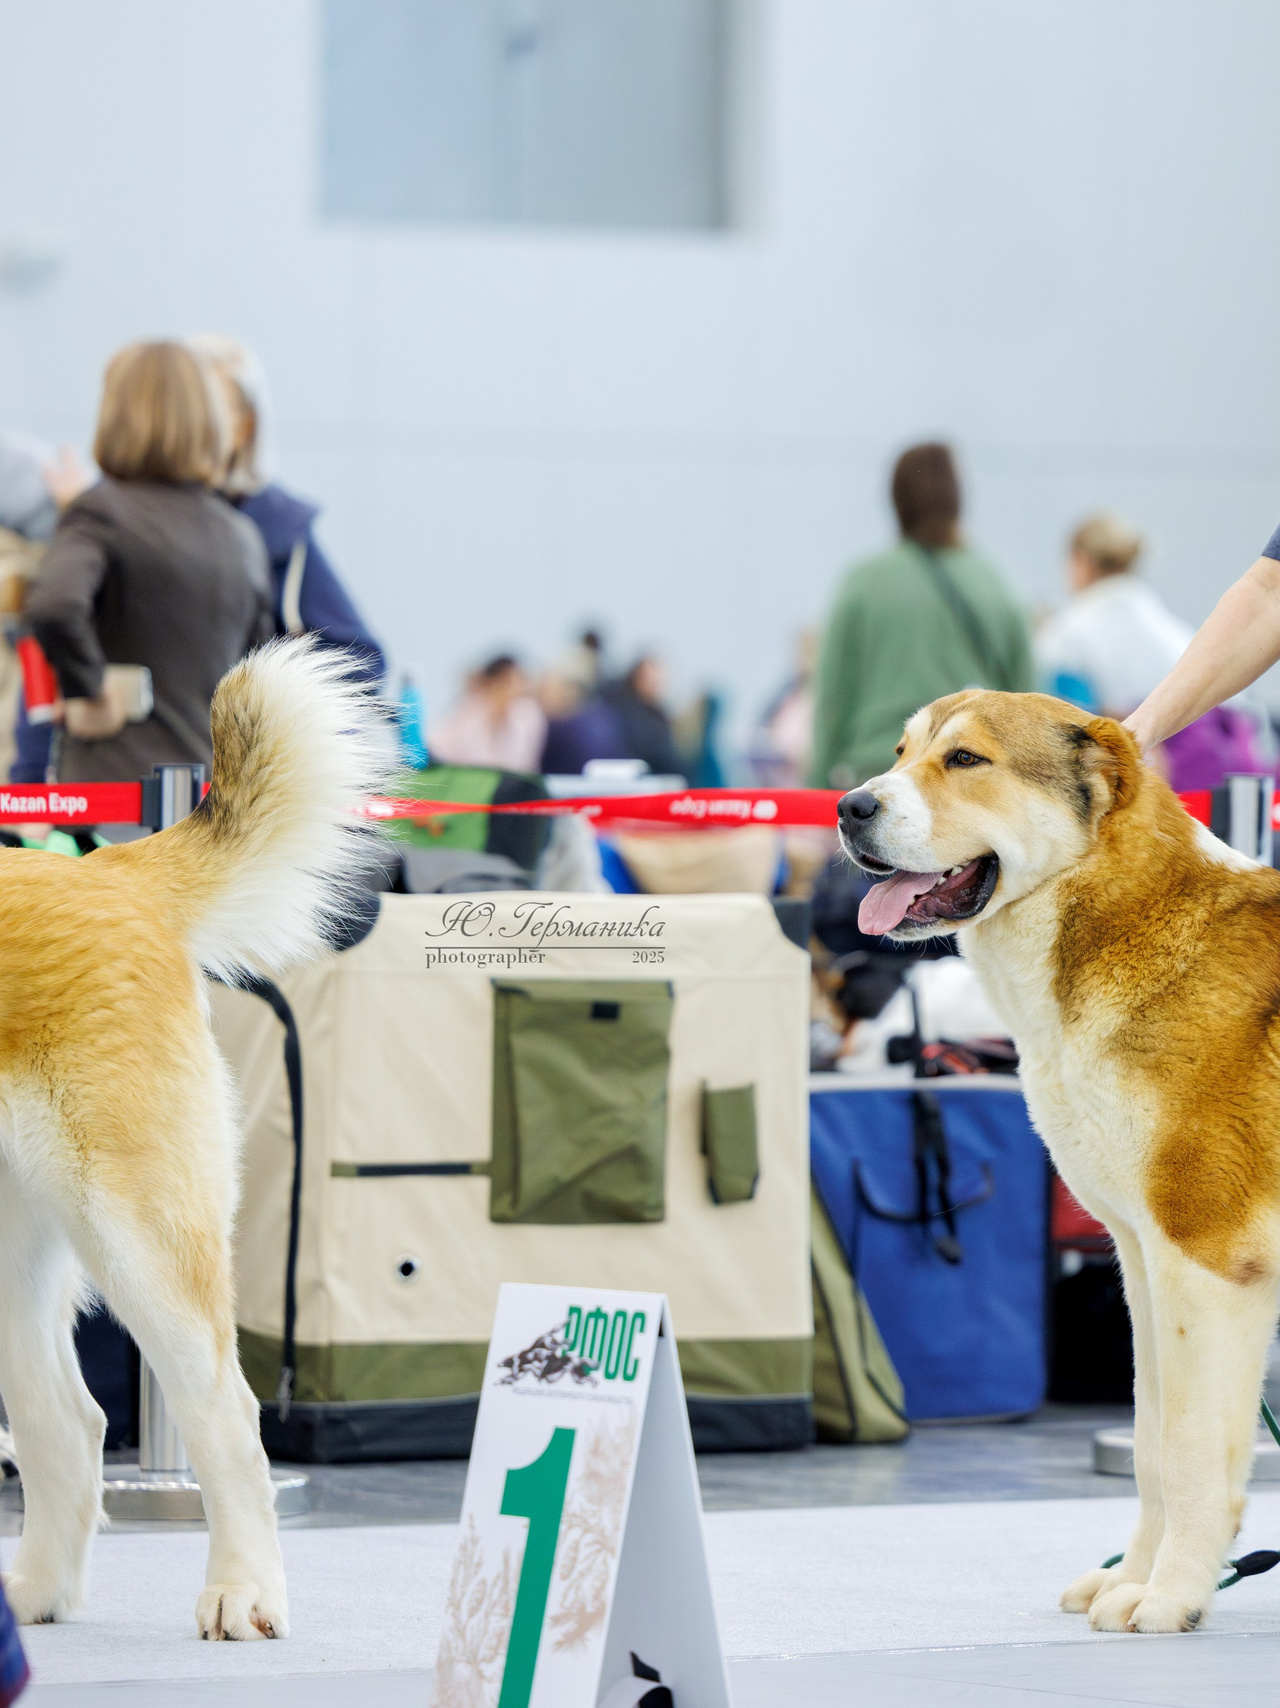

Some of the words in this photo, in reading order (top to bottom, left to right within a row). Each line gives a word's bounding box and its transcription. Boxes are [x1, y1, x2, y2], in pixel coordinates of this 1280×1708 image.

[0, 792, 47, 813] Kazan
[48, 792, 88, 817] Expo
[498, 1426, 577, 1708] 1
